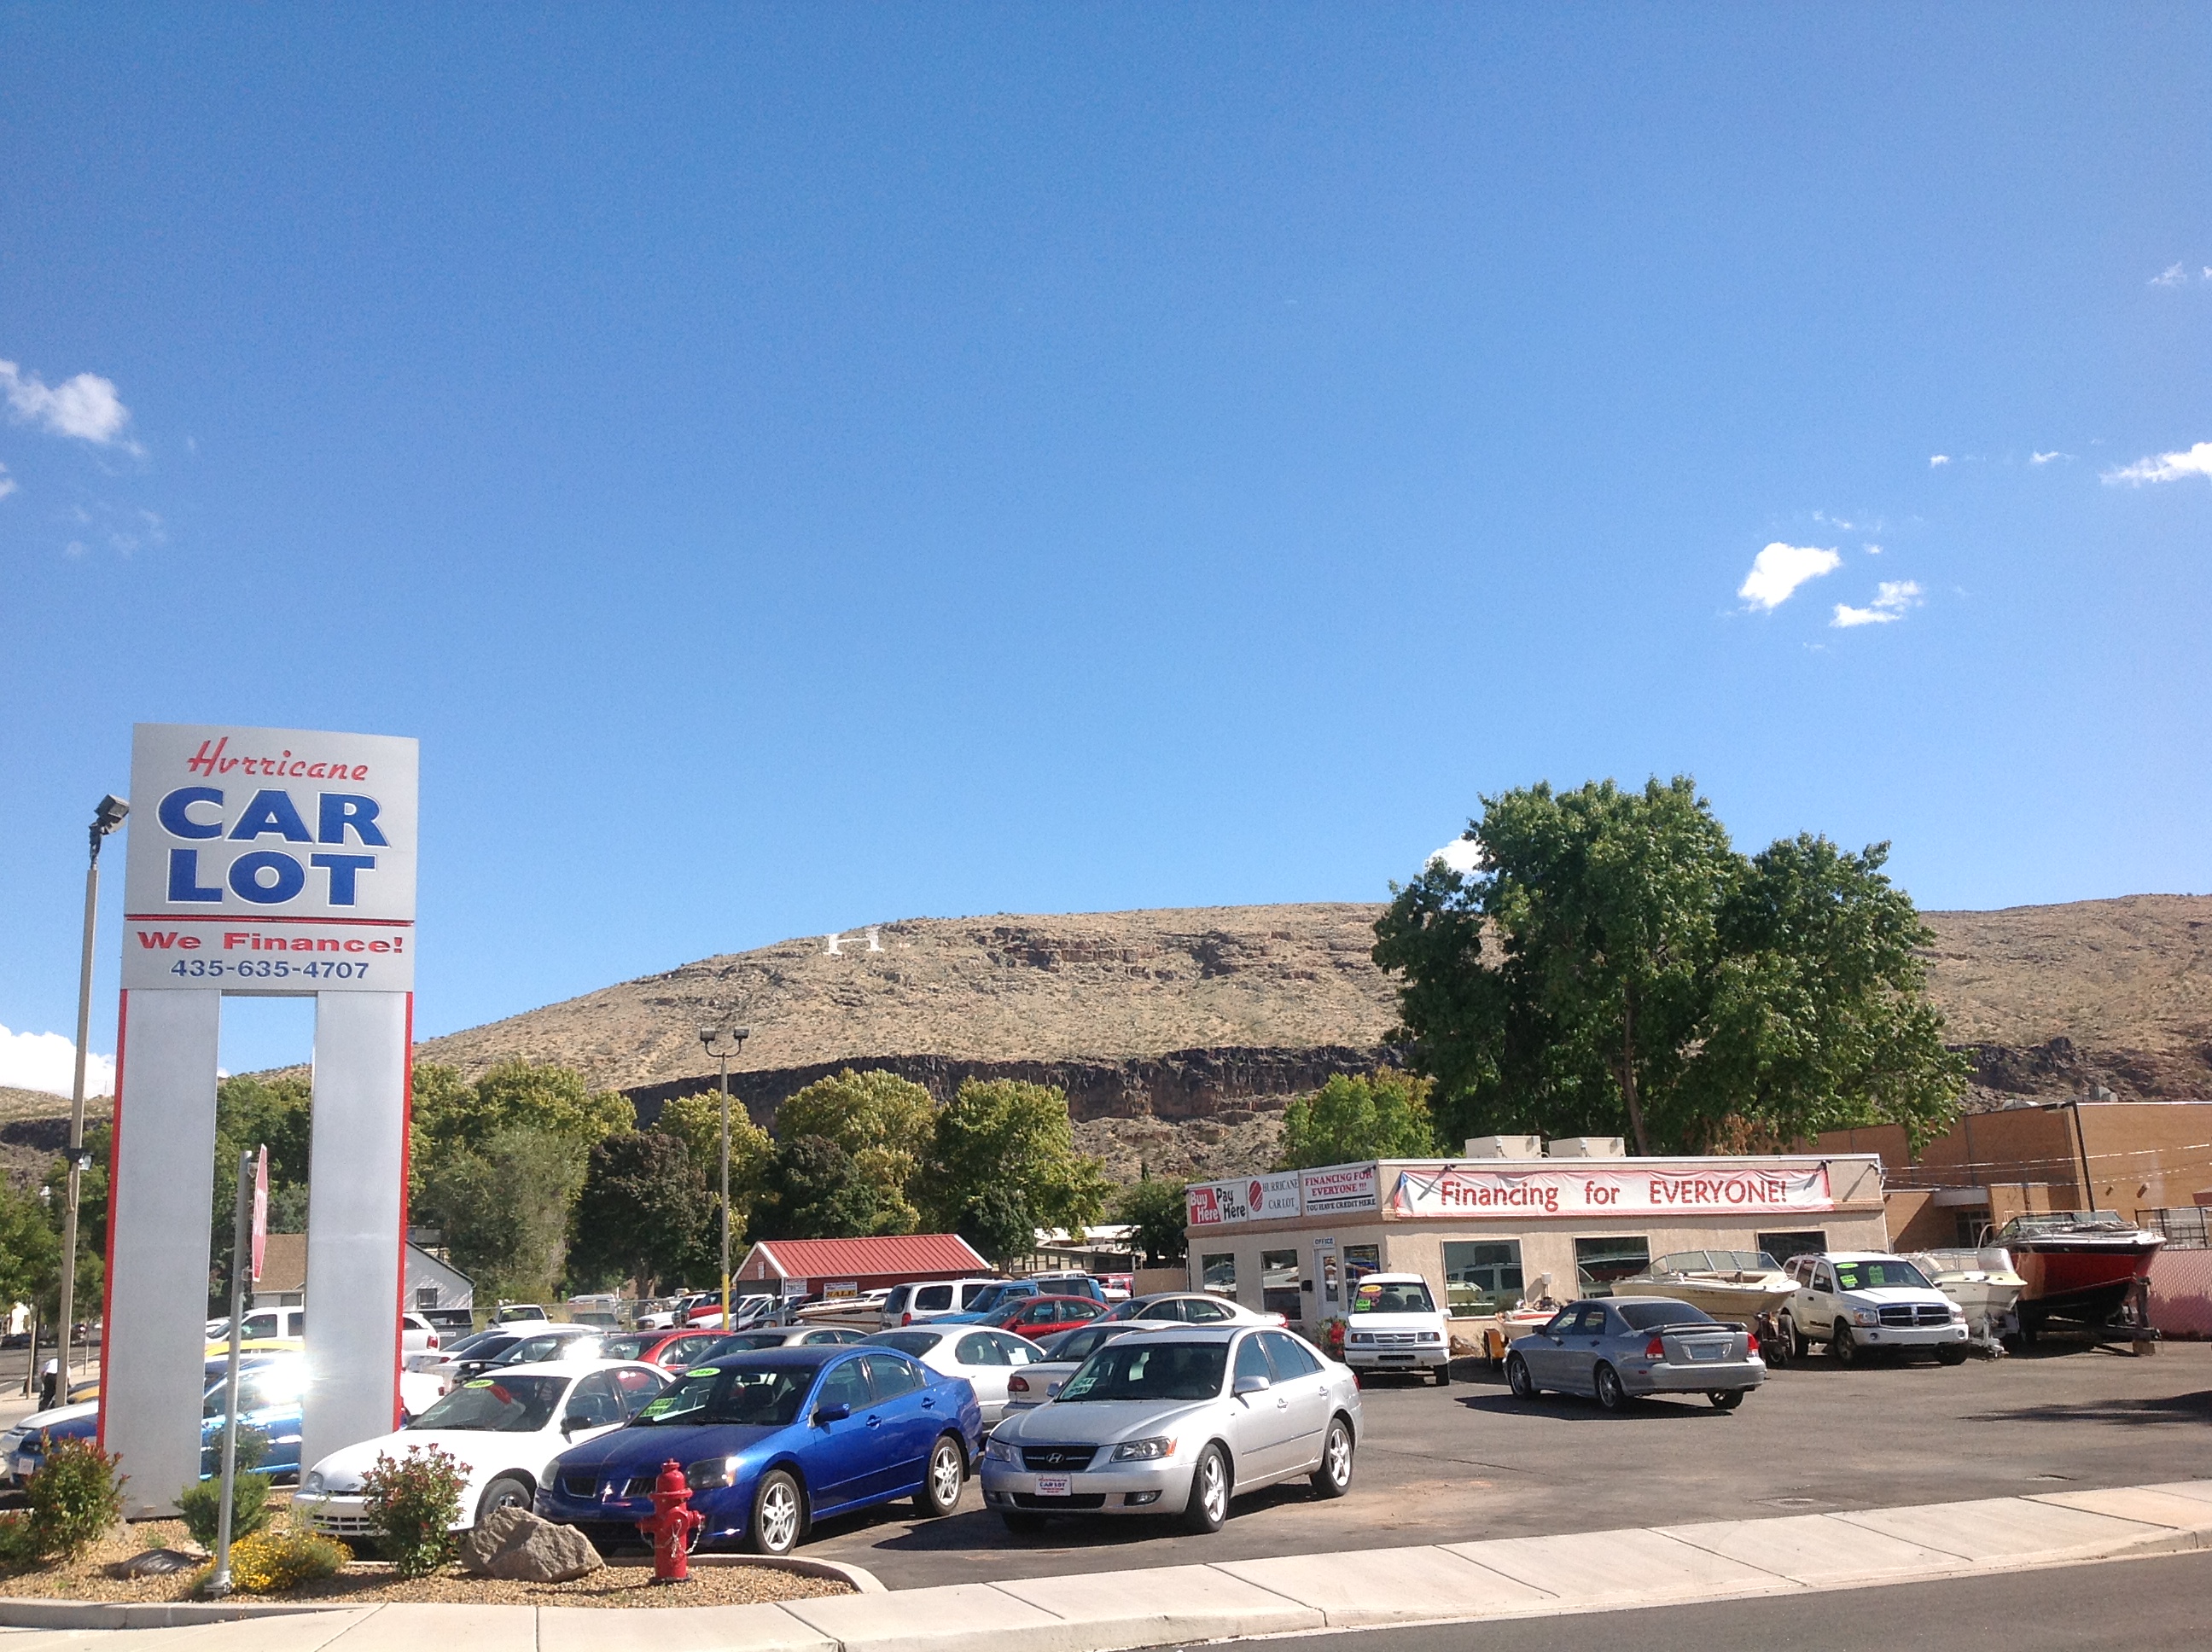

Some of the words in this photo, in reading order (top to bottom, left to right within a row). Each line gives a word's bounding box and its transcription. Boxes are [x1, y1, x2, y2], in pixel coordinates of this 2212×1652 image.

[186, 736, 369, 781] Hurricane
[155, 786, 392, 848] CAR
[166, 848, 377, 907] LOT
[137, 931, 202, 950] We
[223, 932, 404, 954] Finance!
[169, 959, 370, 980] 435-635-4707
[1262, 1178, 1299, 1193] HURRICANE
[1305, 1172, 1353, 1187] FINANCING
[1353, 1171, 1373, 1181] FOR
[1216, 1187, 1234, 1206] Pay
[1311, 1183, 1358, 1196] EVERYONE
[1441, 1181, 1559, 1213] Financing
[1585, 1180, 1621, 1205] for
[1649, 1180, 1787, 1204] EVERYONE!
[1190, 1190, 1208, 1209] Buy
[1318, 1202, 1335, 1211] HAVE
[1336, 1200, 1359, 1209] CREDIT
[1359, 1199, 1376, 1207] HERE
[1196, 1206, 1219, 1223] Here
[1223, 1202, 1246, 1221] Here
